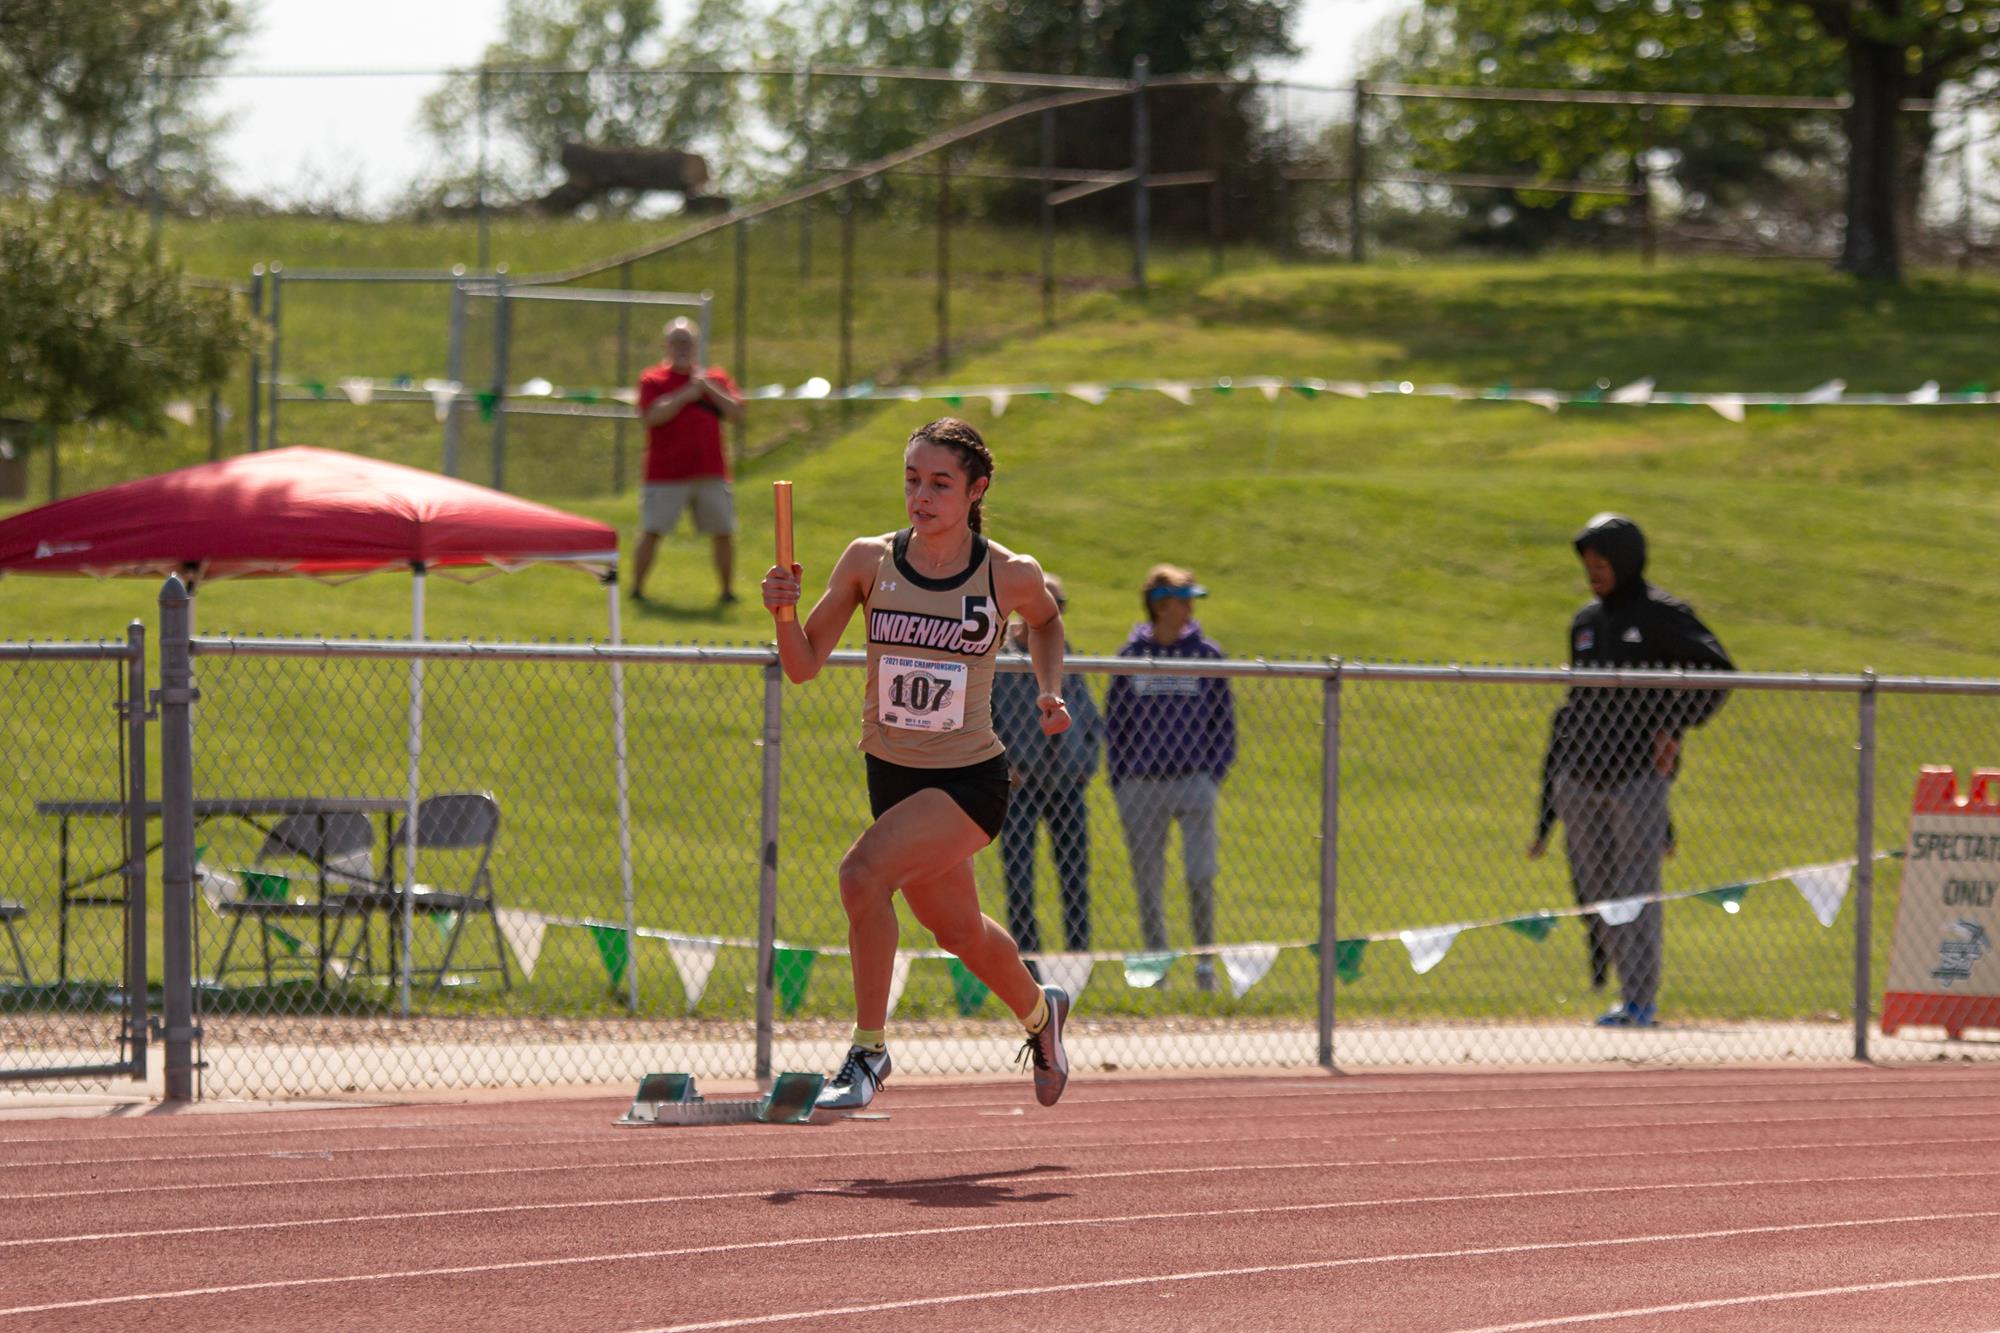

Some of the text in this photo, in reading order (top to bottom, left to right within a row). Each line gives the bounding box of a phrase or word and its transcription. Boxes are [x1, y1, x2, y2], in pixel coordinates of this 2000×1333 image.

[961, 596, 990, 643] 5
[885, 657, 898, 665] 2021
[914, 660, 962, 672] CHAMPIONSHIPS
[892, 674, 952, 712] 107
[1911, 832, 2000, 861] SPECTAT
[1943, 879, 1998, 907] ONLY
